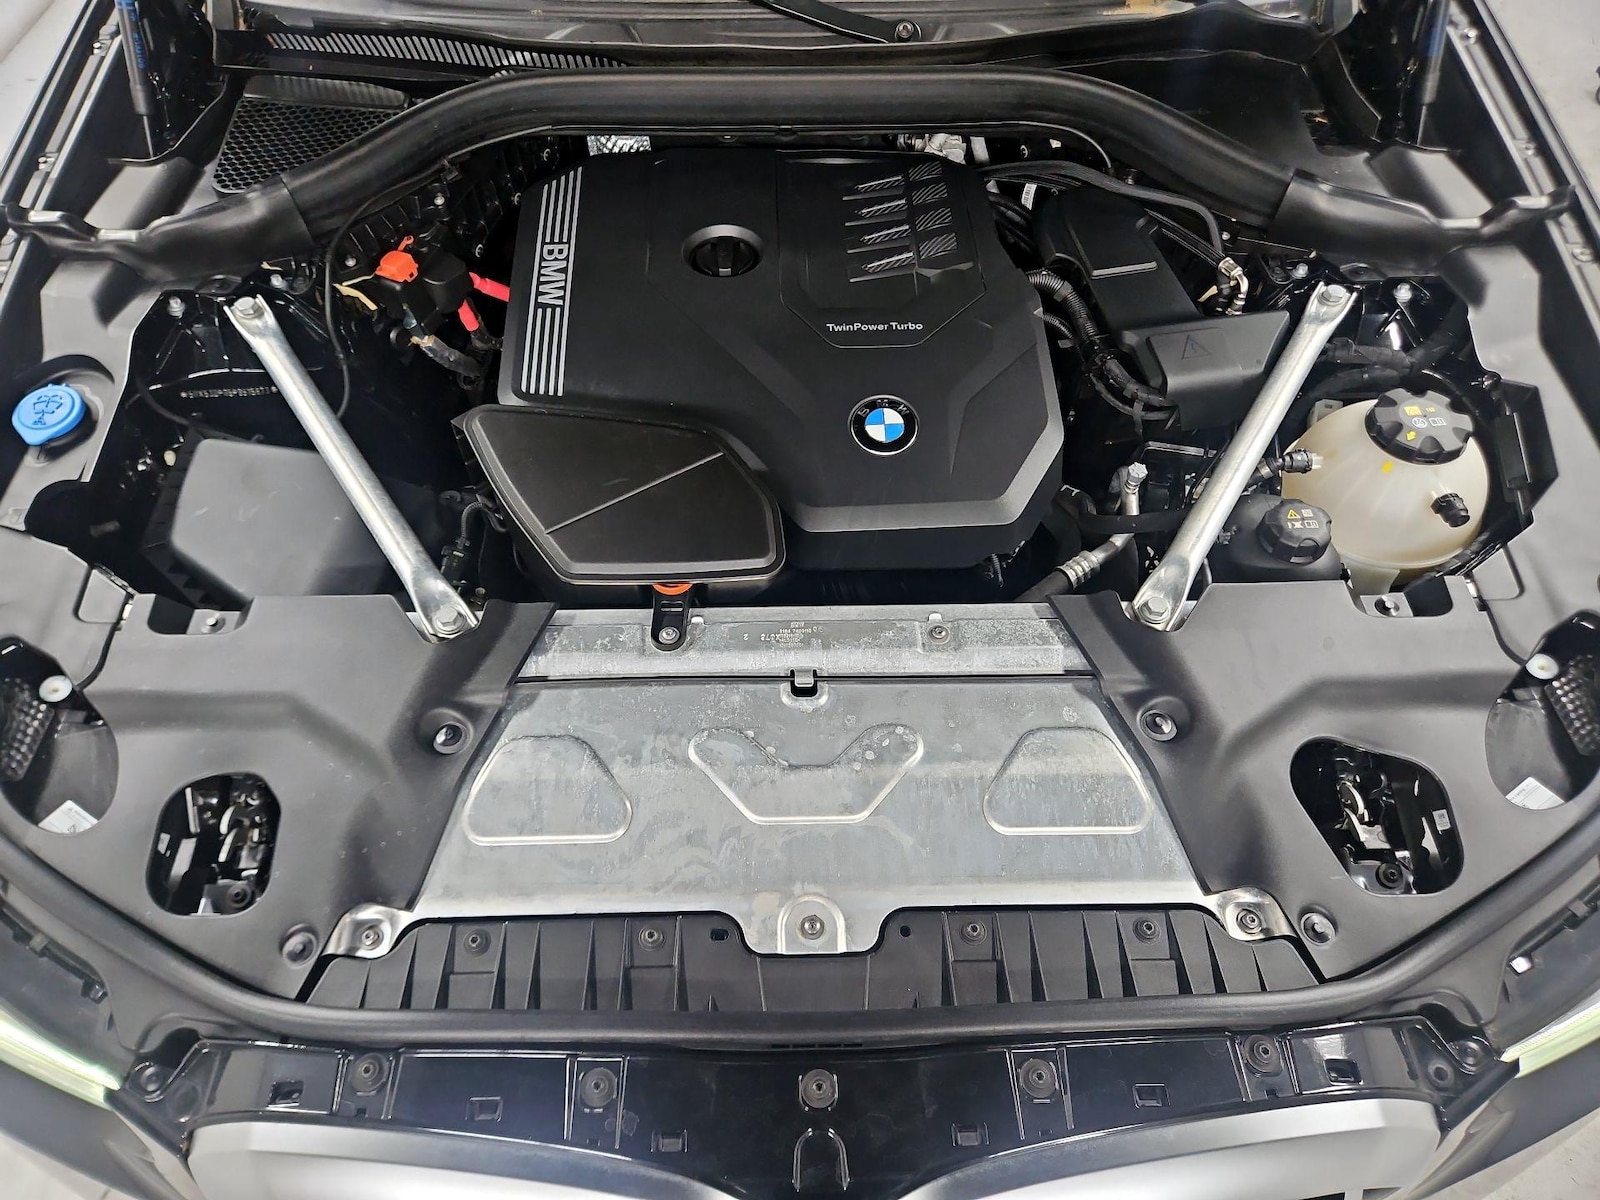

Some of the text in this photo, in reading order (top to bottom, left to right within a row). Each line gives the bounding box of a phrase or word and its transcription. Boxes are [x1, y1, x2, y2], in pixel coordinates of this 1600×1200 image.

[537, 243, 569, 305] BMW
[826, 322, 924, 332] TwinPower Turbo
